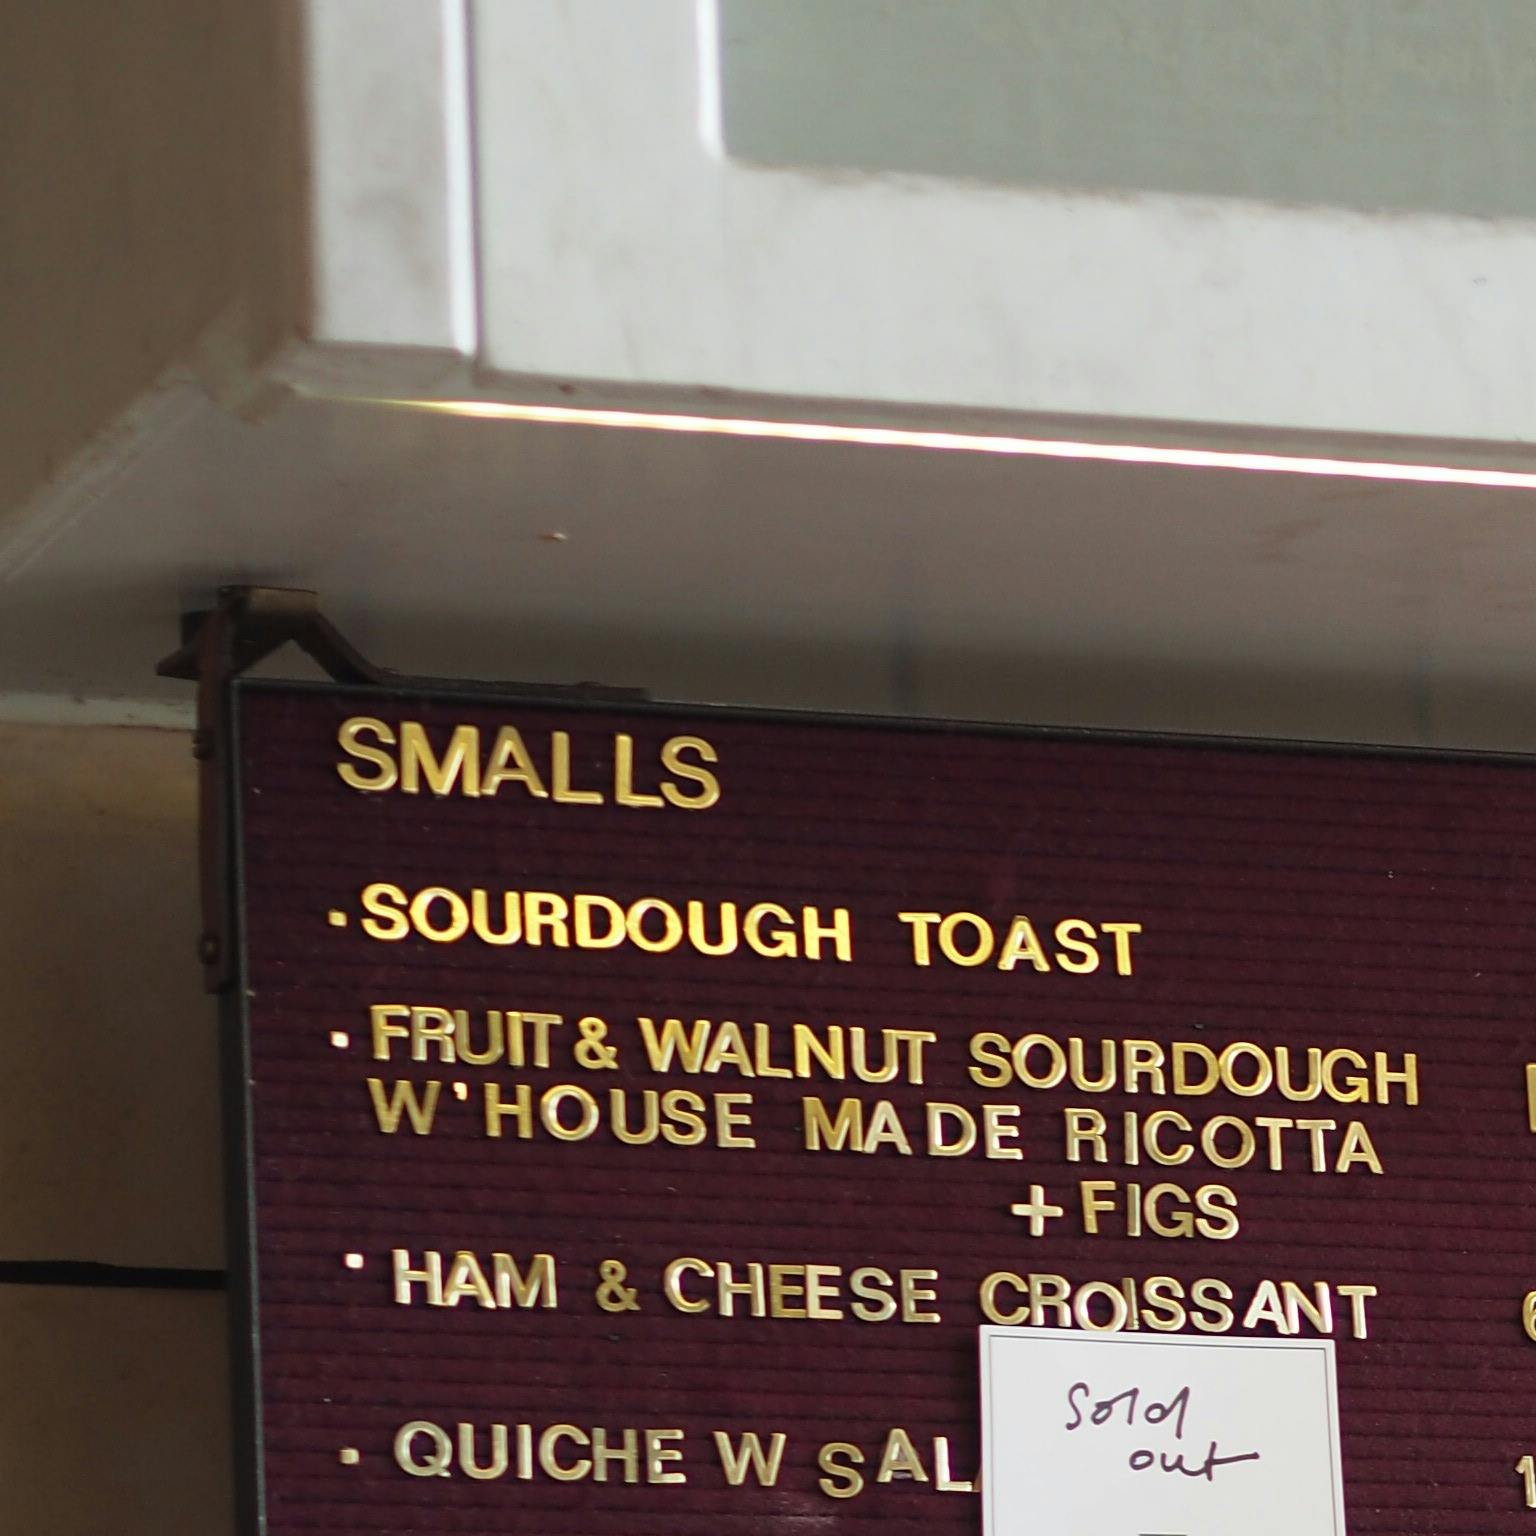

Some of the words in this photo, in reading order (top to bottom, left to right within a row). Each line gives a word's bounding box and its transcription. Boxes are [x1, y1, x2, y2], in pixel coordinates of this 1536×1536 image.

[338, 717, 720, 809] SMALLS
[362, 883, 851, 961] SOURDOUGH
[898, 912, 1141, 975] TOAST
[371, 1005, 563, 1068] FRUIT
[575, 1017, 618, 1069] &
[638, 1018, 936, 1084] WALNUT
[969, 1033, 1418, 1105] SOURDOUGH
[803, 1097, 1023, 1160] MADE
[1064, 1108, 1383, 1174] RICOTTA
[1081, 1181, 1239, 1239] FIGS
[393, 1249, 557, 1308] HAM
[596, 1260, 640, 1312] &
[665, 1258, 941, 1323] CHEESE
[978, 1270, 1378, 1340] CROISSANT
[1064, 1382, 1192, 1440] Sold
[395, 1421, 686, 1483] QUICHE
[714, 1431, 786, 1486] W
[817, 1427, 983, 1499] SAL
[1128, 1440, 1262, 1480] out
